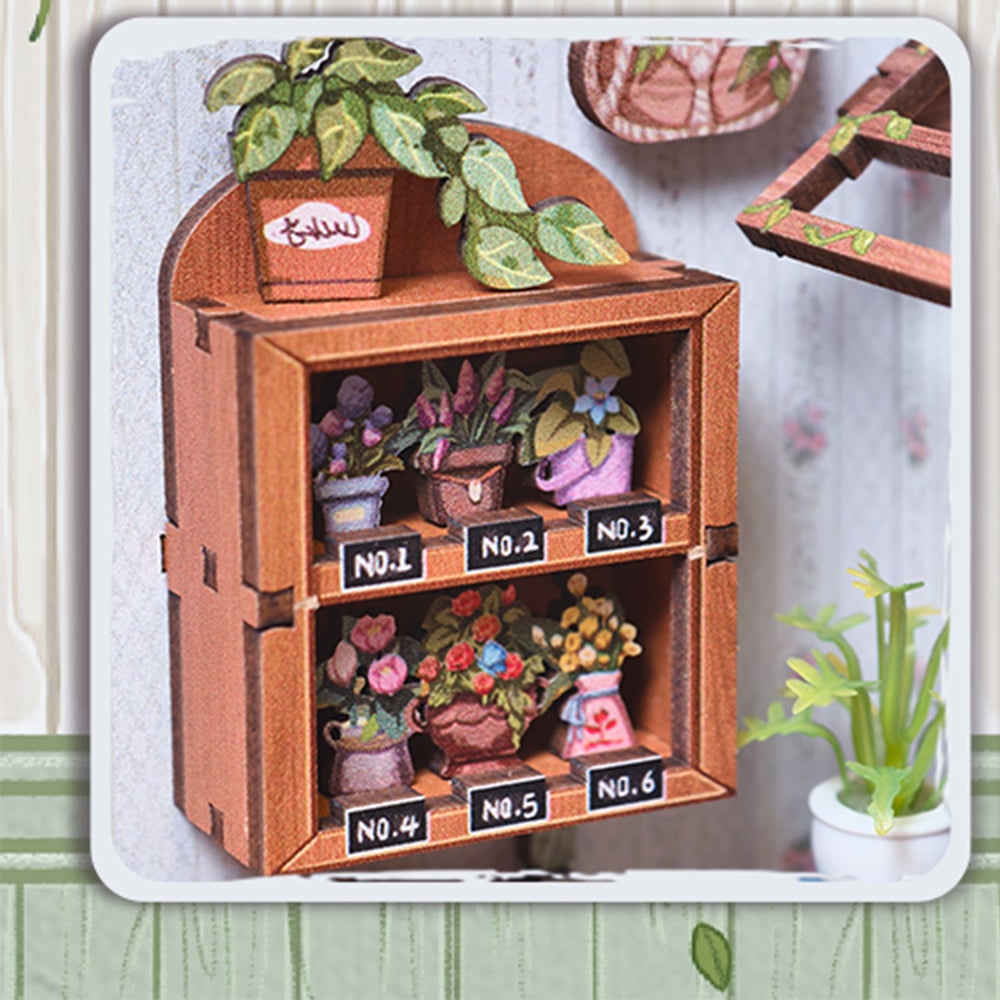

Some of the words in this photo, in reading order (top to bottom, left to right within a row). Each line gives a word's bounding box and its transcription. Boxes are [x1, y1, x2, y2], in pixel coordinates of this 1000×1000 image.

[596, 514, 654, 542] NO.3
[481, 530, 539, 559] NO.2
[354, 547, 412, 579] NO.1
[597, 769, 656, 800] NO.6
[481, 792, 539, 823] NO.5
[356, 813, 420, 844] NO.4
